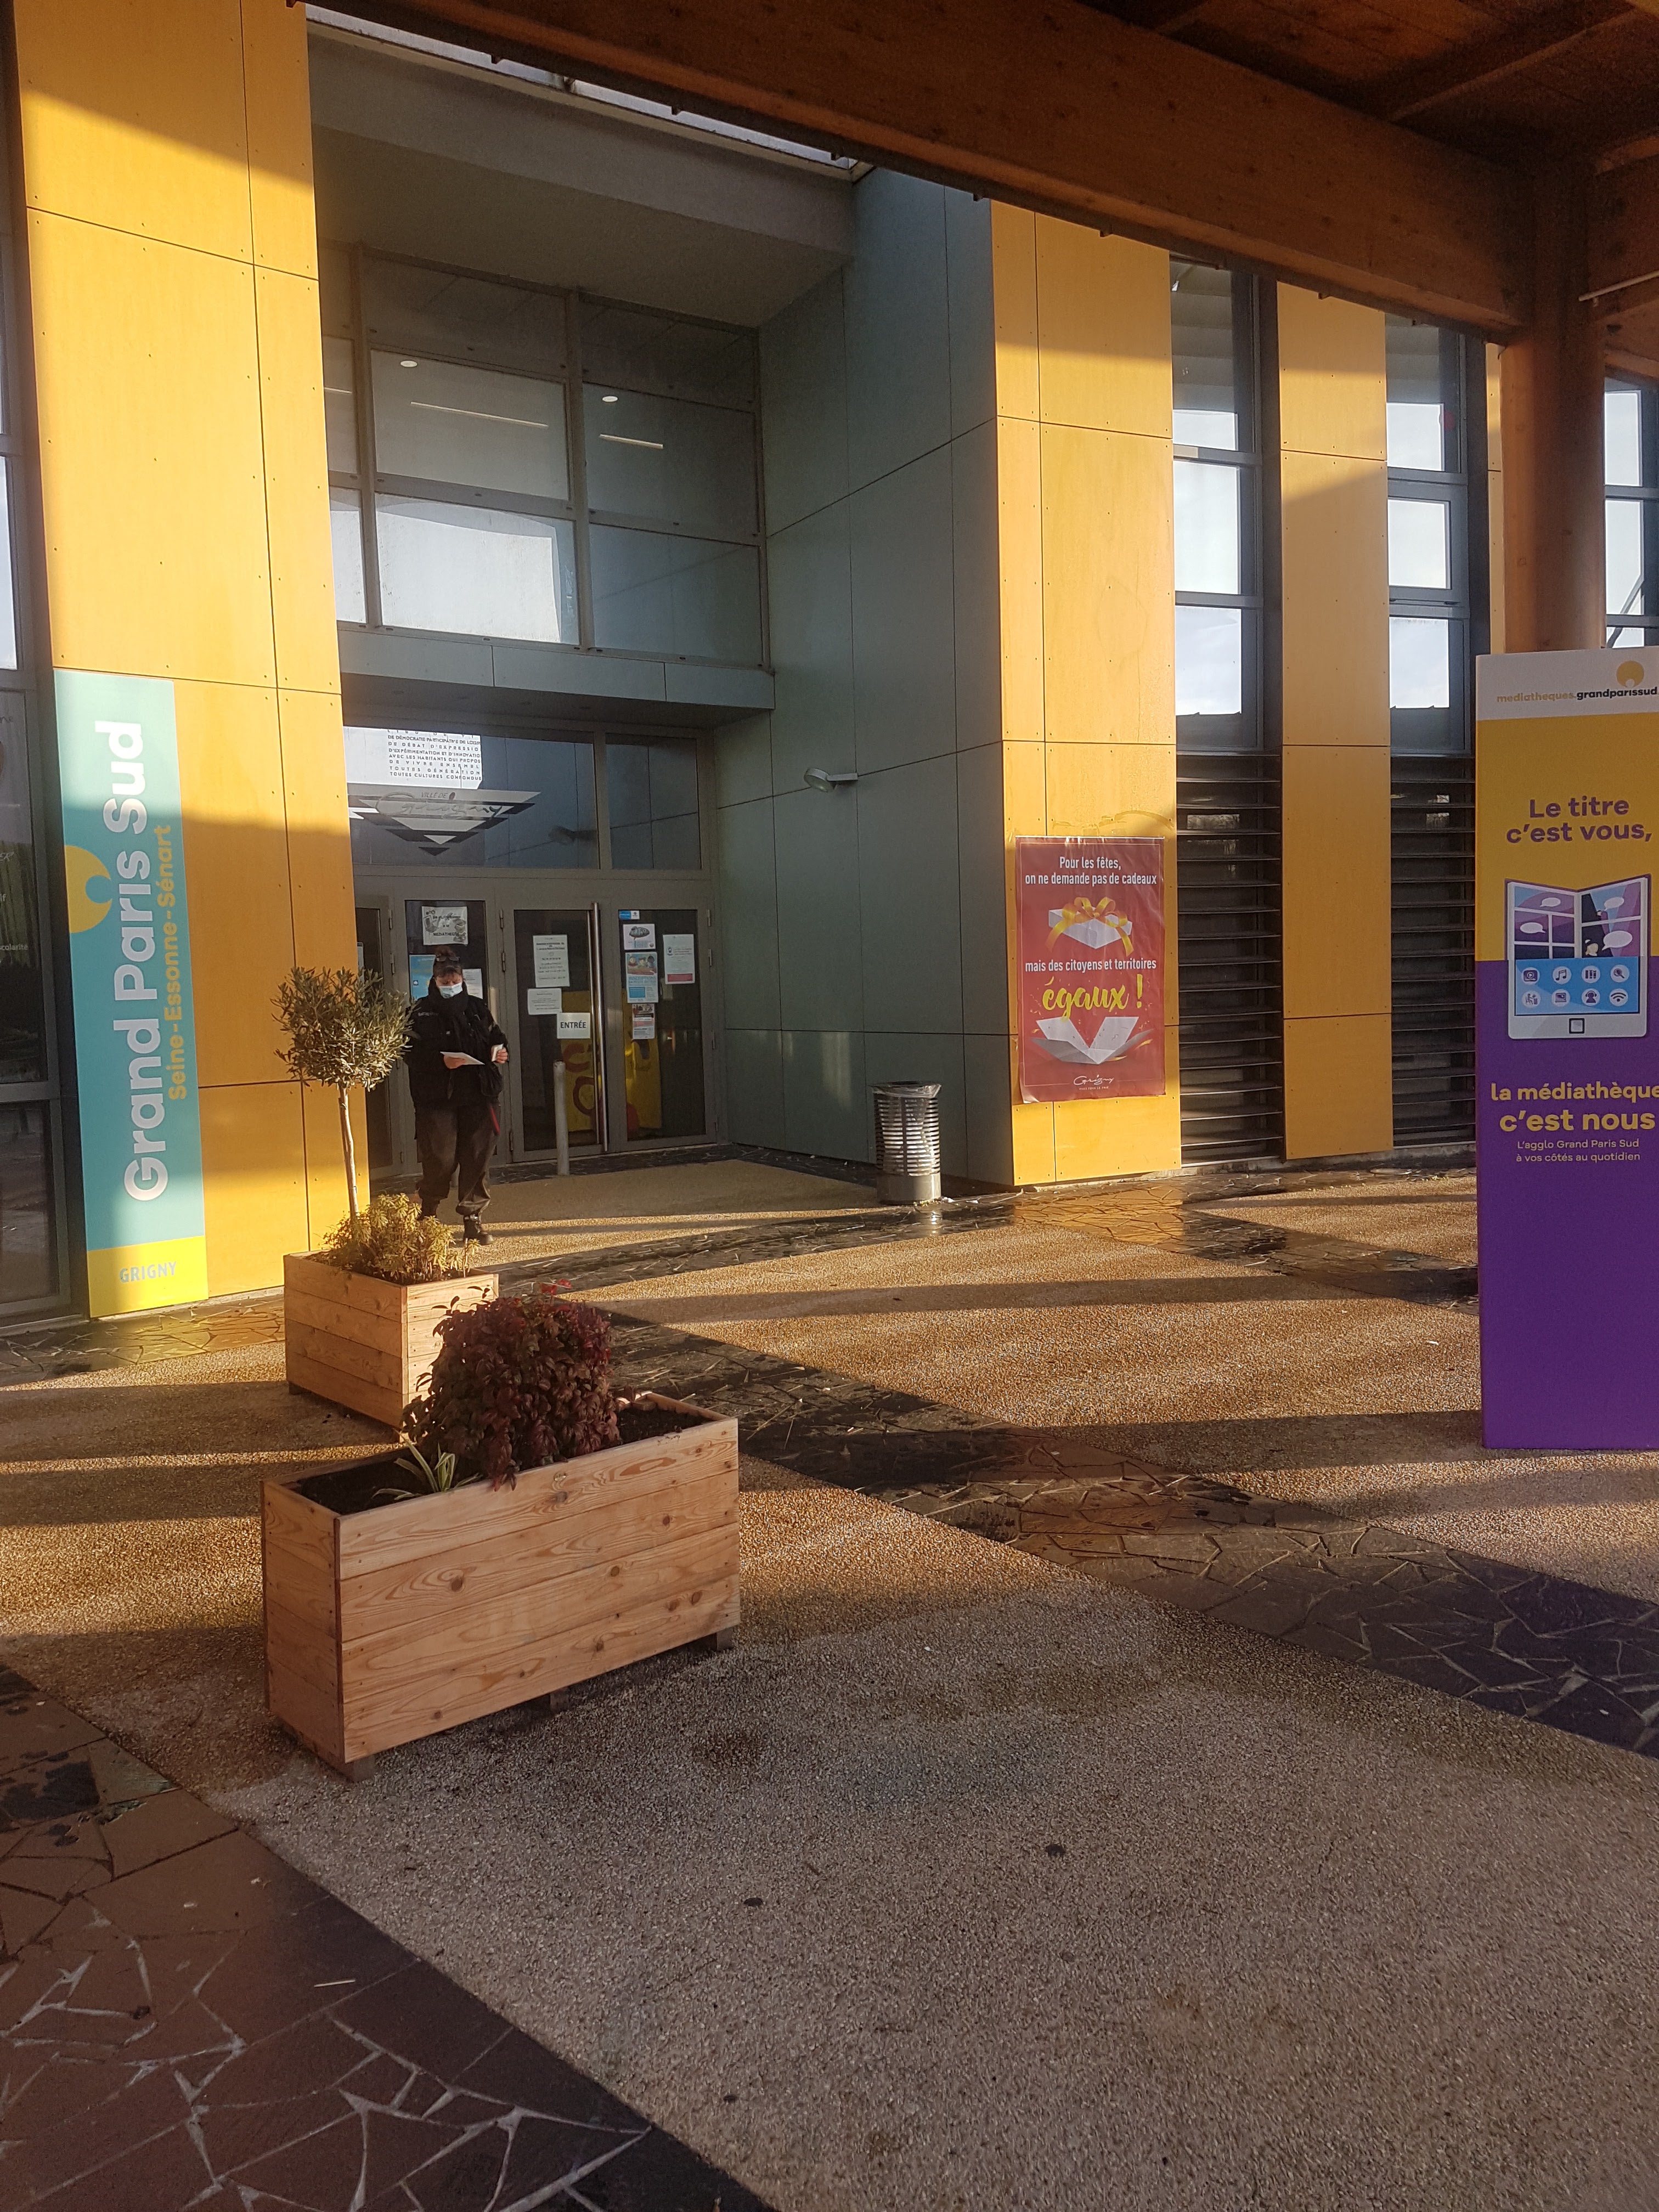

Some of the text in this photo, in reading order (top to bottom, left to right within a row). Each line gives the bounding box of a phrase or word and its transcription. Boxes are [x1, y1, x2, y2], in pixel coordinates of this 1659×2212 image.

[1530, 795, 1629, 819] Le titre
[1506, 822, 1652, 844] c'est vous,
[1059, 856, 1121, 871] Pour les fêtes,
[1025, 872, 1157, 887] on ne demande pas de cadeaux
[94, 720, 168, 1201] Grand Paris Sud
[1025, 957, 1156, 973] mais des citoyens et territoires
[1042, 974, 1143, 1023] égaux !
[560, 1020, 587, 1029] ENTRÉE
[1073, 1074, 1115, 1085] Grigny
[1491, 1082, 1511, 1101] la
[1499, 1109, 1656, 1132] c'est nous
[1517, 1138, 1640, 1150] L'agglo Grand Paris Sud
[1516, 1153, 1522, 1162] à
[1544, 1153, 1573, 1161] côtés
[1590, 1152, 1640, 1164] quotidien
[119, 1261, 177, 1283] GRIGNY
